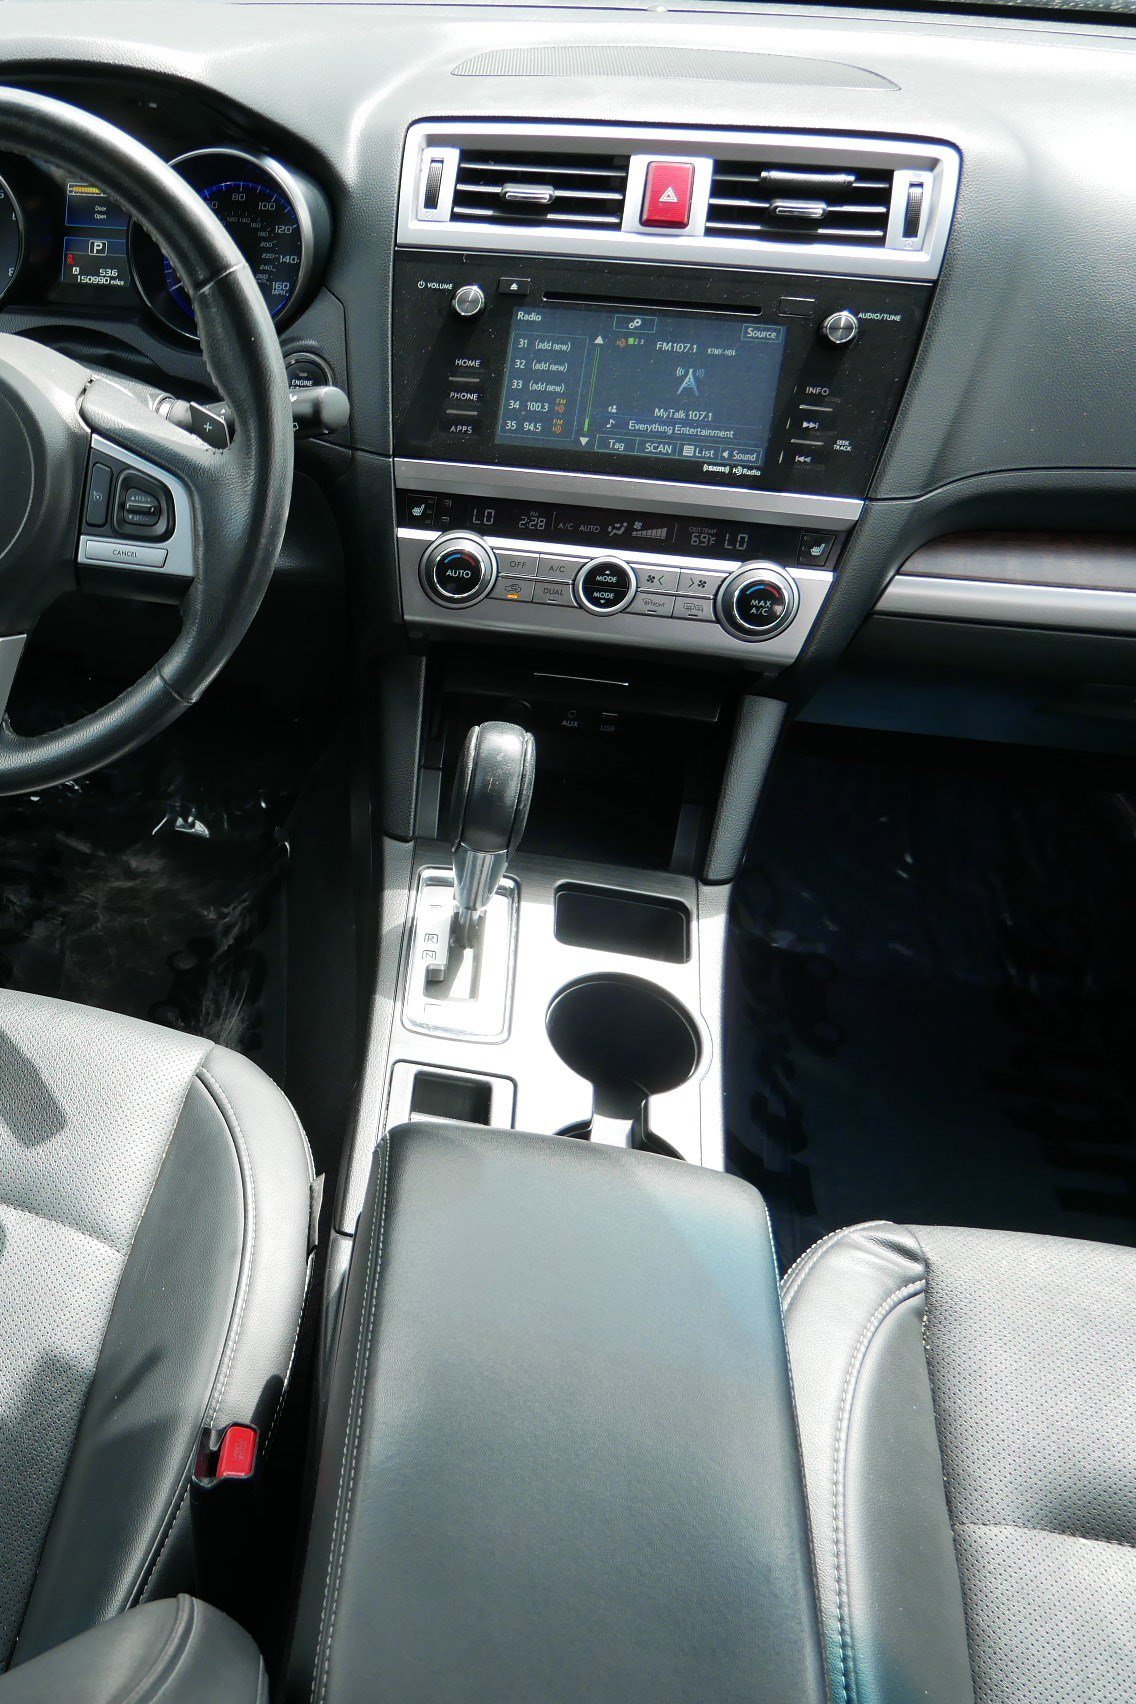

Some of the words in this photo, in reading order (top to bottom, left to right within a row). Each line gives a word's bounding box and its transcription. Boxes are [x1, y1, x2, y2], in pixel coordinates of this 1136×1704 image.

[231, 193, 246, 201] 80
[258, 202, 276, 211] 100
[275, 225, 292, 234] 120
[94, 242, 103, 254] P
[280, 255, 297, 264] 140
[99, 269, 118, 277] 53.6
[77, 275, 110, 284] 150990
[272, 282, 290, 290] 160
[427, 282, 453, 290] VOLUME
[517, 311, 542, 321] Radio
[857, 312, 902, 322] AUDIO/TUNE
[747, 327, 777, 339] Source
[518, 339, 528, 348] 31
[535, 340, 552, 350] (add
[552, 342, 571, 352] new)
[656, 341, 697, 353] FM107.1
[455, 358, 481, 368] HOME
[515, 360, 525, 369] 32
[532, 360, 549, 371] (add
[550, 363, 568, 373] new)
[512, 380, 523, 389] 33
[529, 381, 546, 391] (add
[546, 383, 565, 393] new)
[805, 386, 830, 396] INFO
[449, 391, 478, 401] PHONE
[509, 400, 519, 409] 34
[527, 402, 549, 412] 100.3
[654, 408, 685, 419] MyTalk
[688, 411, 713, 421] 107.1
[450, 425, 473, 434] APPS
[506, 421, 516, 430] 35
[524, 422, 542, 432] 94.5
[629, 421, 672, 435] Everything
[675, 425, 734, 438] Entertainment
[608, 440, 625, 451] Tag
[645, 443, 672, 453] SCAN
[696, 448, 714, 457] List
[733, 451, 757, 461] Sound
[473, 508, 495, 525] LO
[519, 516, 546, 530] 2:28
[558, 522, 574, 531] A/C
[579, 524, 600, 533] AUTO
[725, 533, 748, 550] LO
[112, 549, 138, 558] CANCEL
[510, 560, 527, 569] OFF
[548, 565, 565, 573] A/C
[446, 570, 471, 579] AUTO
[595, 575, 618, 583] MODE
[543, 587, 564, 596] DUAL
[593, 591, 614, 600] MODE
[751, 599, 771, 608] MAX
[750, 607, 769, 616] A/C
